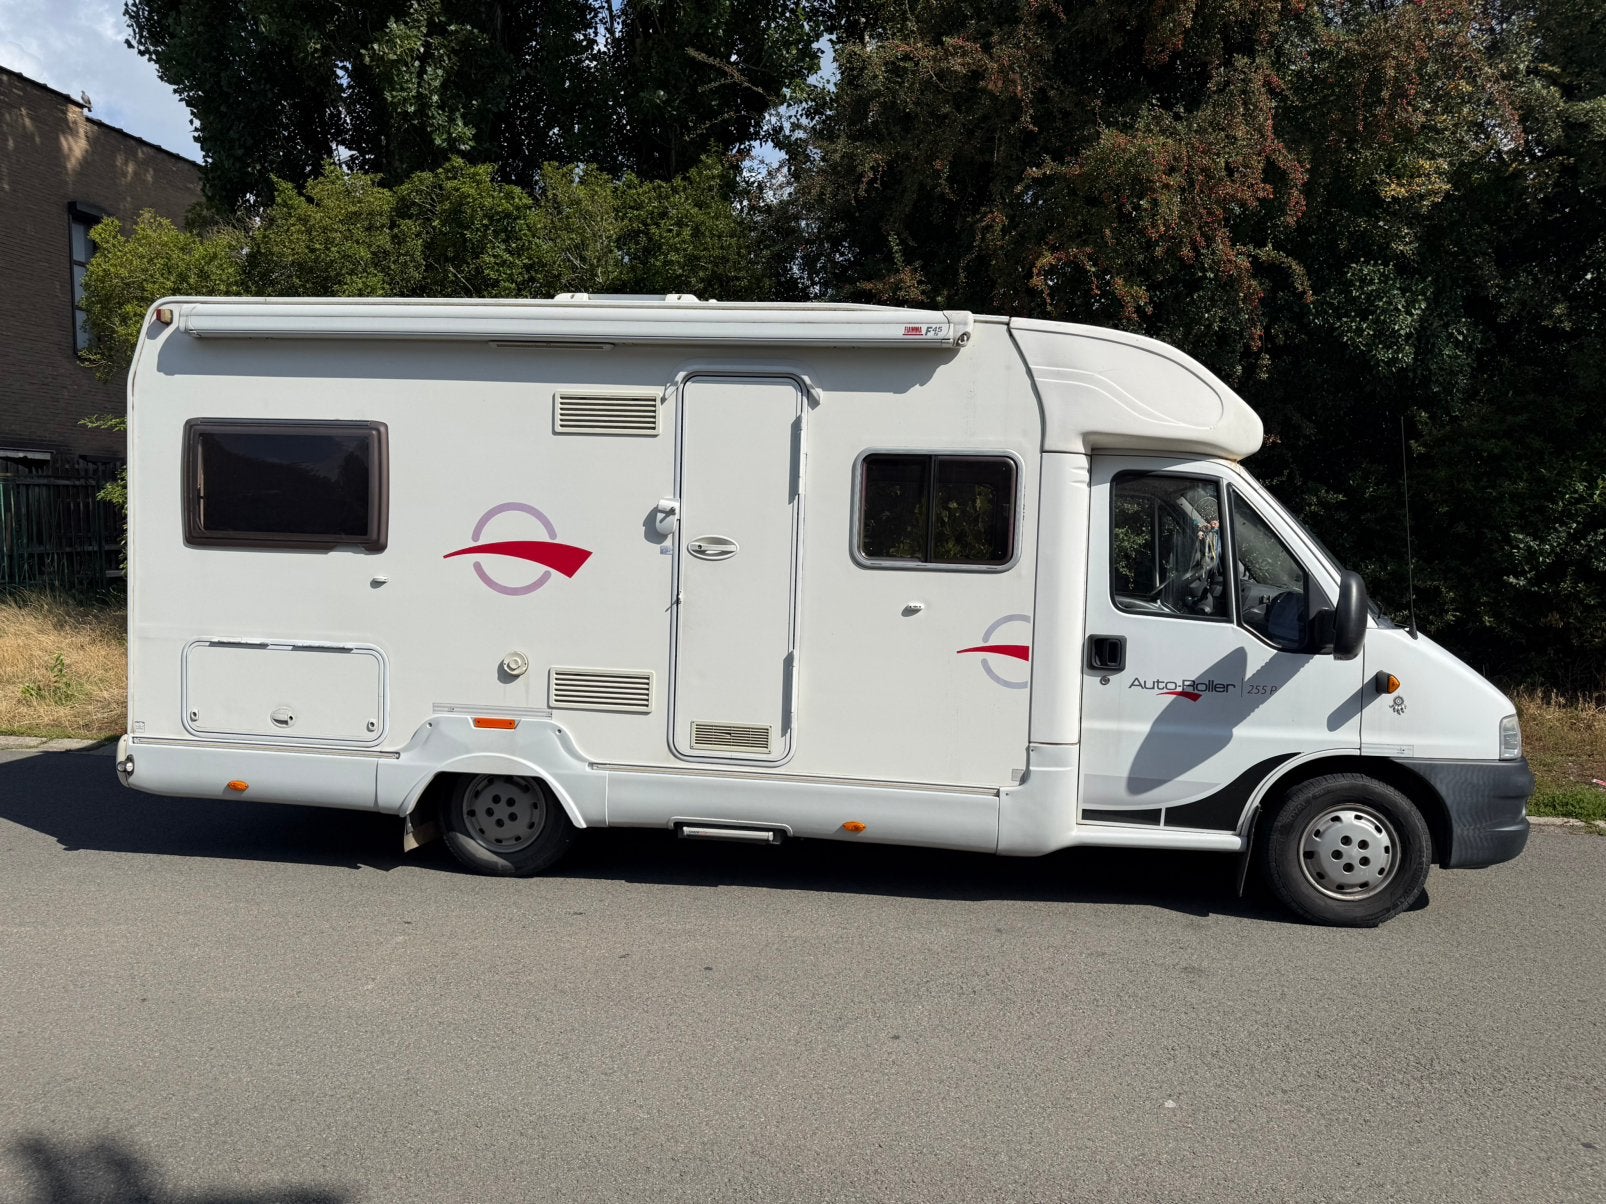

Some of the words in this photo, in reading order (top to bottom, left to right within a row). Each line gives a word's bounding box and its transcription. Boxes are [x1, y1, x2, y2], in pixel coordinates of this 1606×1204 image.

[1128, 677, 1236, 693] Auto-Roller
[1247, 684, 1268, 695] 255
[1269, 685, 1278, 695] P
